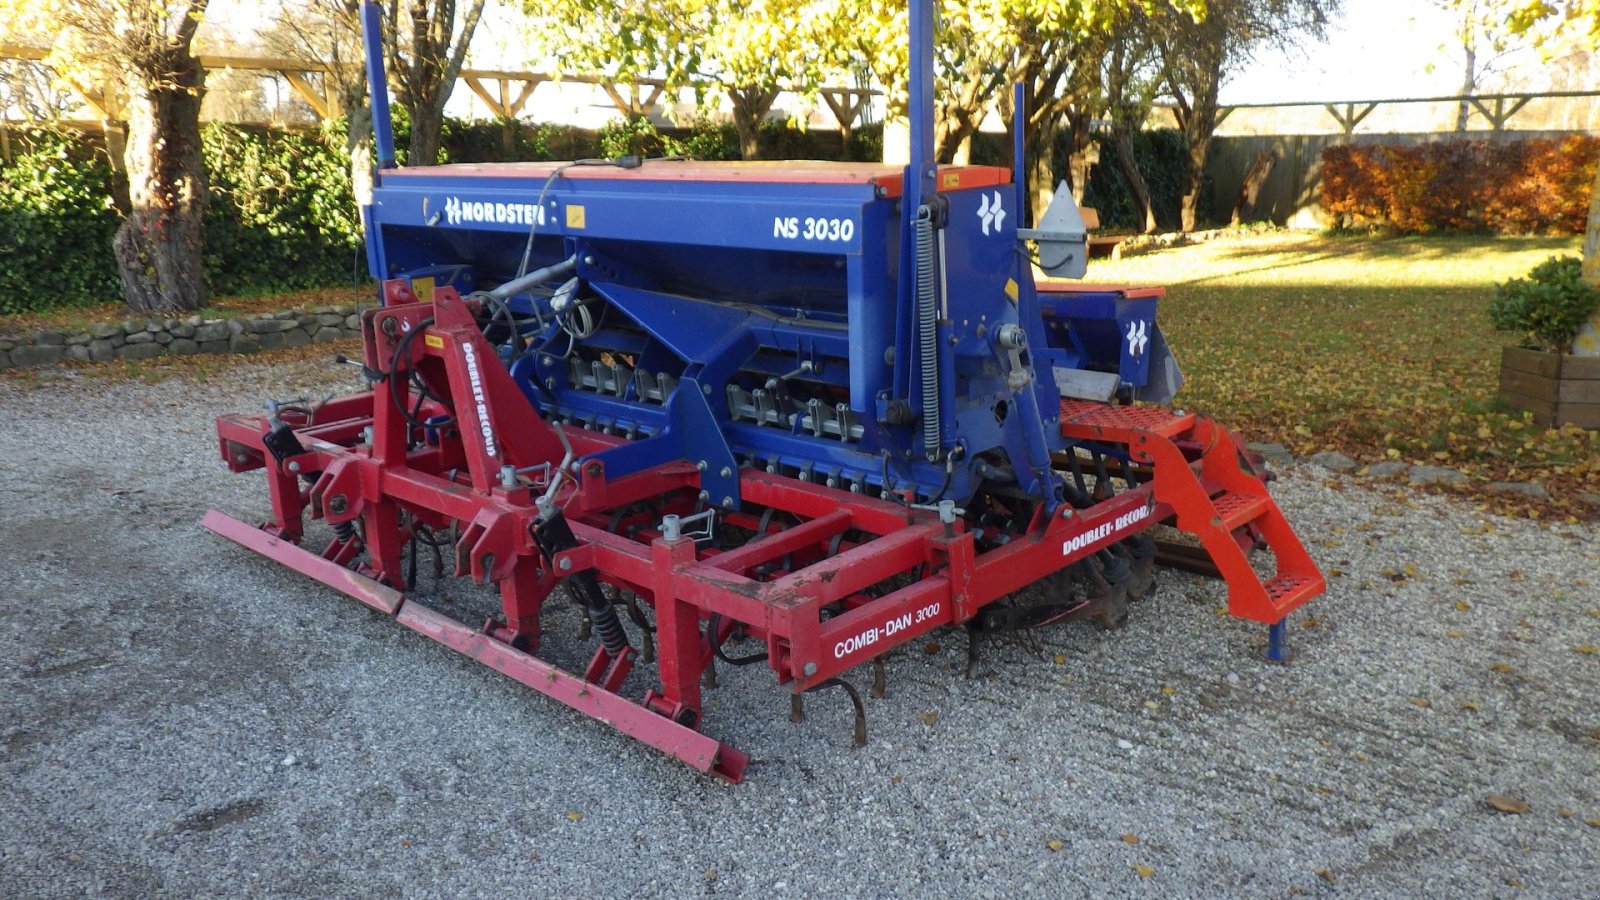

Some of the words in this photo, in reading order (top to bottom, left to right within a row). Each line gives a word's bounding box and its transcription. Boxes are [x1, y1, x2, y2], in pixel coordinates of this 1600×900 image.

[462, 201, 545, 226] NORDSTEN
[773, 216, 799, 239] NS
[803, 217, 854, 242] 3030
[834, 612, 912, 658] COMBI-DAN
[915, 602, 940, 624] 3000
